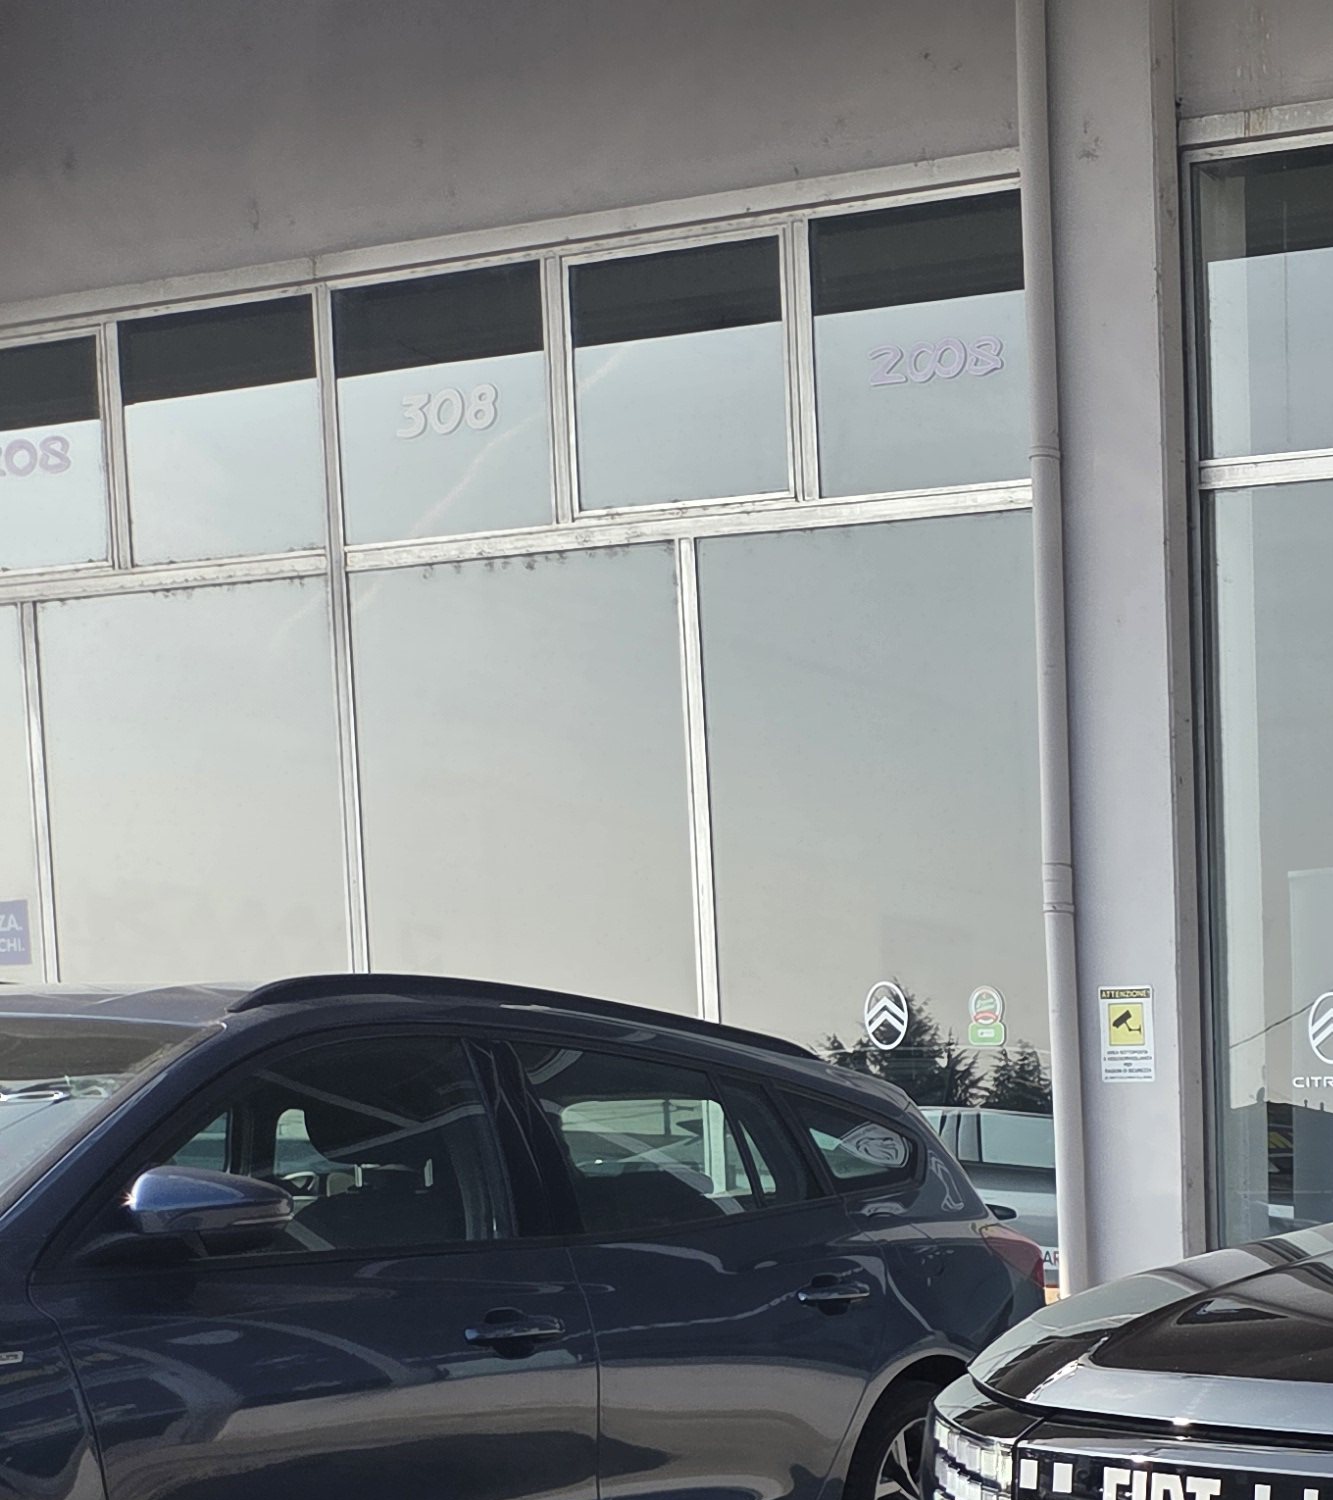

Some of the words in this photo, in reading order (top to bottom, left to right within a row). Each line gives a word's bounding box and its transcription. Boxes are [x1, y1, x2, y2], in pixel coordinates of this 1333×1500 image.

[868, 336, 1004, 387] 2008
[396, 382, 499, 440] 308
[0, 435, 72, 477] 08
